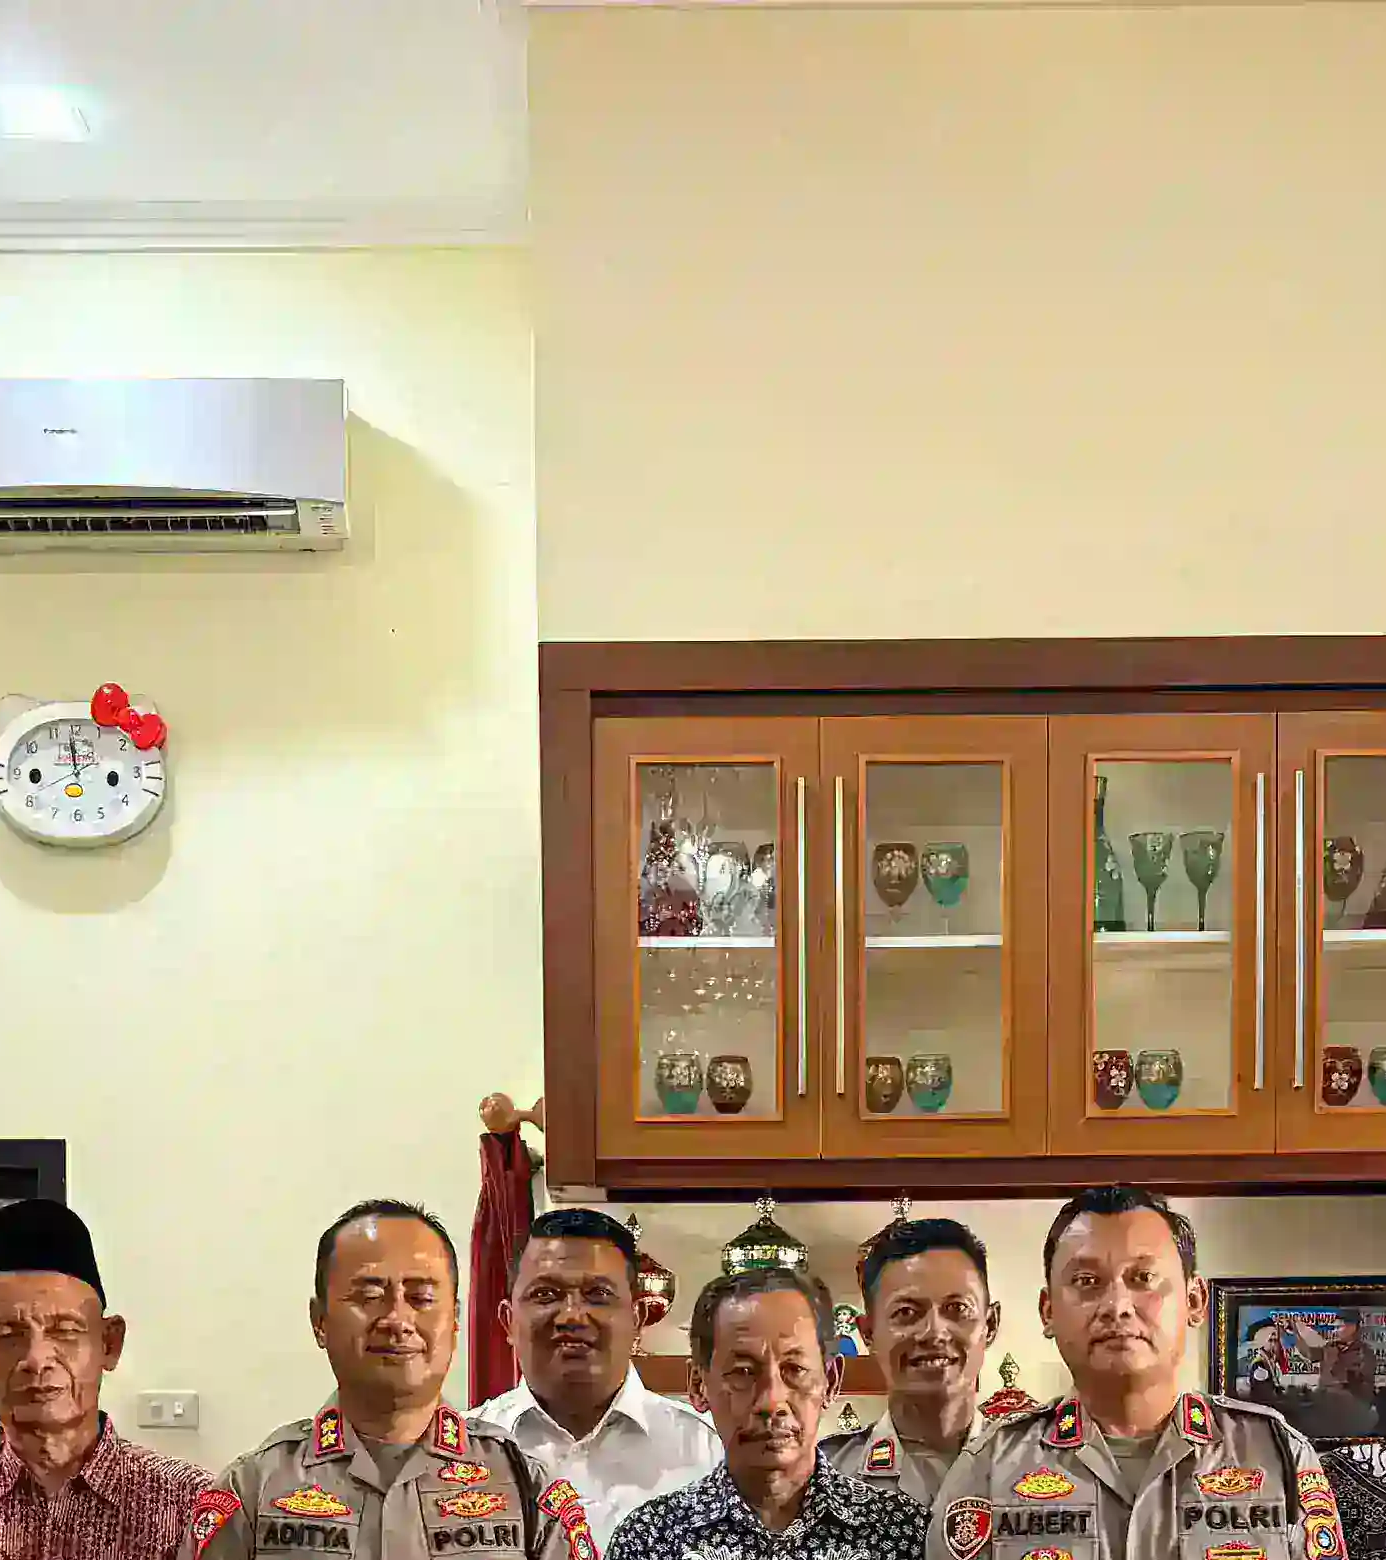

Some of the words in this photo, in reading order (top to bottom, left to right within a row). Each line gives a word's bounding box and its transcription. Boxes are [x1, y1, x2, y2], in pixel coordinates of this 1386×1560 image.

[998, 1510, 1091, 1535] ALBERT
[1184, 1504, 1279, 1531] POLRI
[263, 1522, 350, 1550] ADITYA
[435, 1525, 519, 1550] POLRI
